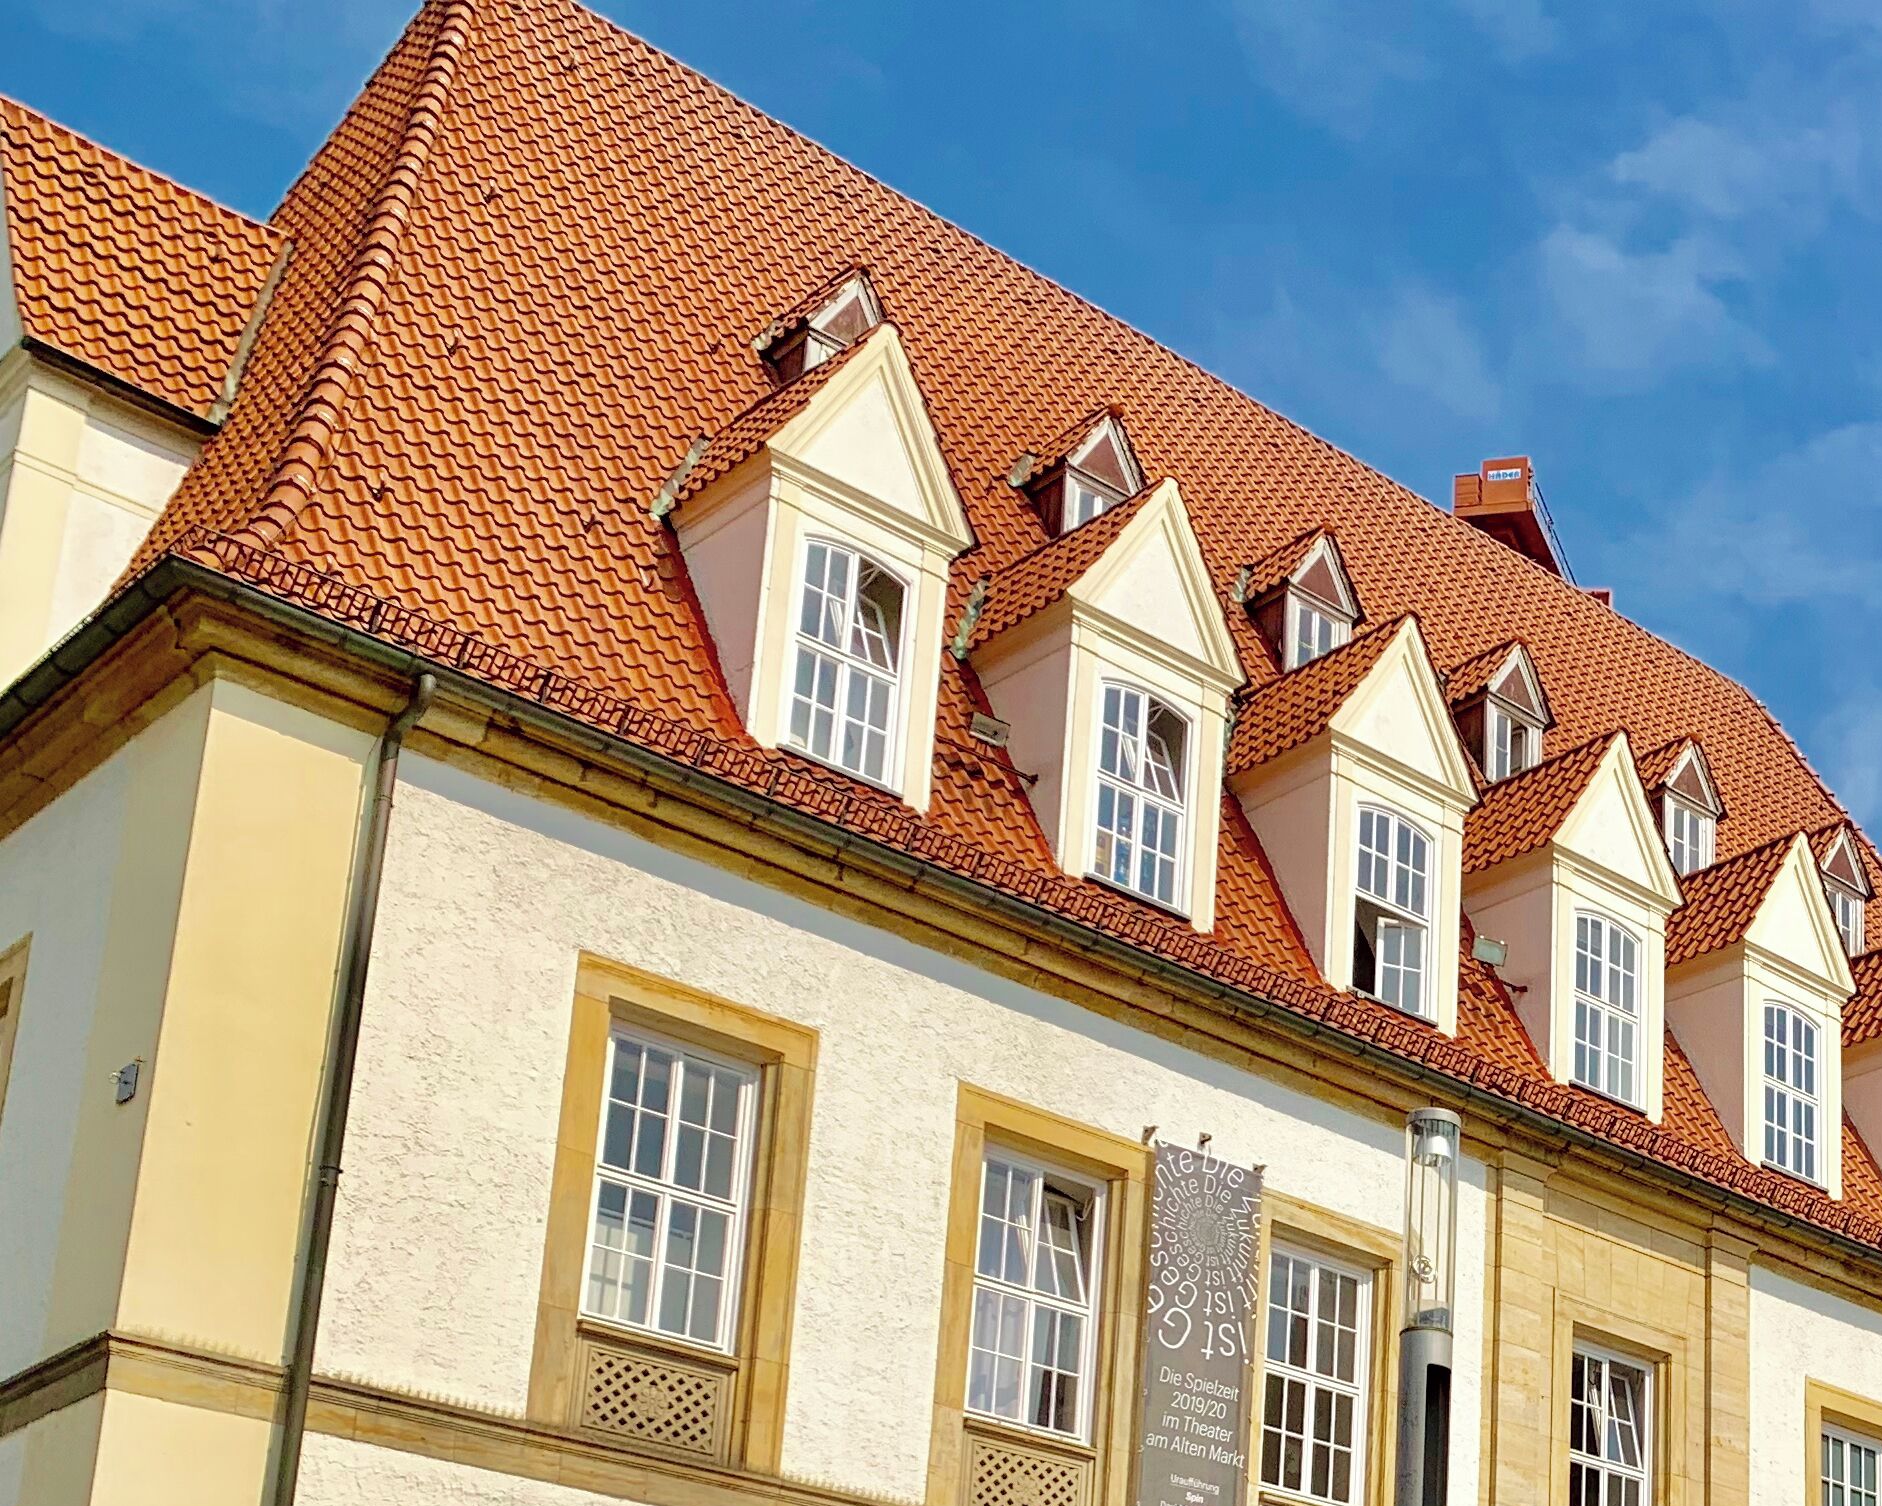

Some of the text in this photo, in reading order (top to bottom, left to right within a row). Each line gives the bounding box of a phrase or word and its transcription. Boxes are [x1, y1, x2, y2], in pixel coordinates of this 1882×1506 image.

[1202, 1156, 1245, 1188] Die
[1204, 1175, 1232, 1203] Die
[1205, 1194, 1224, 1213] Die
[1159, 1178, 1201, 1281] Geschichte
[1227, 1203, 1256, 1283] Zukunft
[1204, 1269, 1226, 1289] ist
[1203, 1290, 1236, 1319] ist
[1200, 1321, 1249, 1364] ist
[1160, 1366, 1240, 1402] Die Spielzeit
[1171, 1392, 1227, 1419] 2019/20
[1162, 1411, 1233, 1443] im Theater
[1146, 1433, 1246, 1469] am Alten Markt
